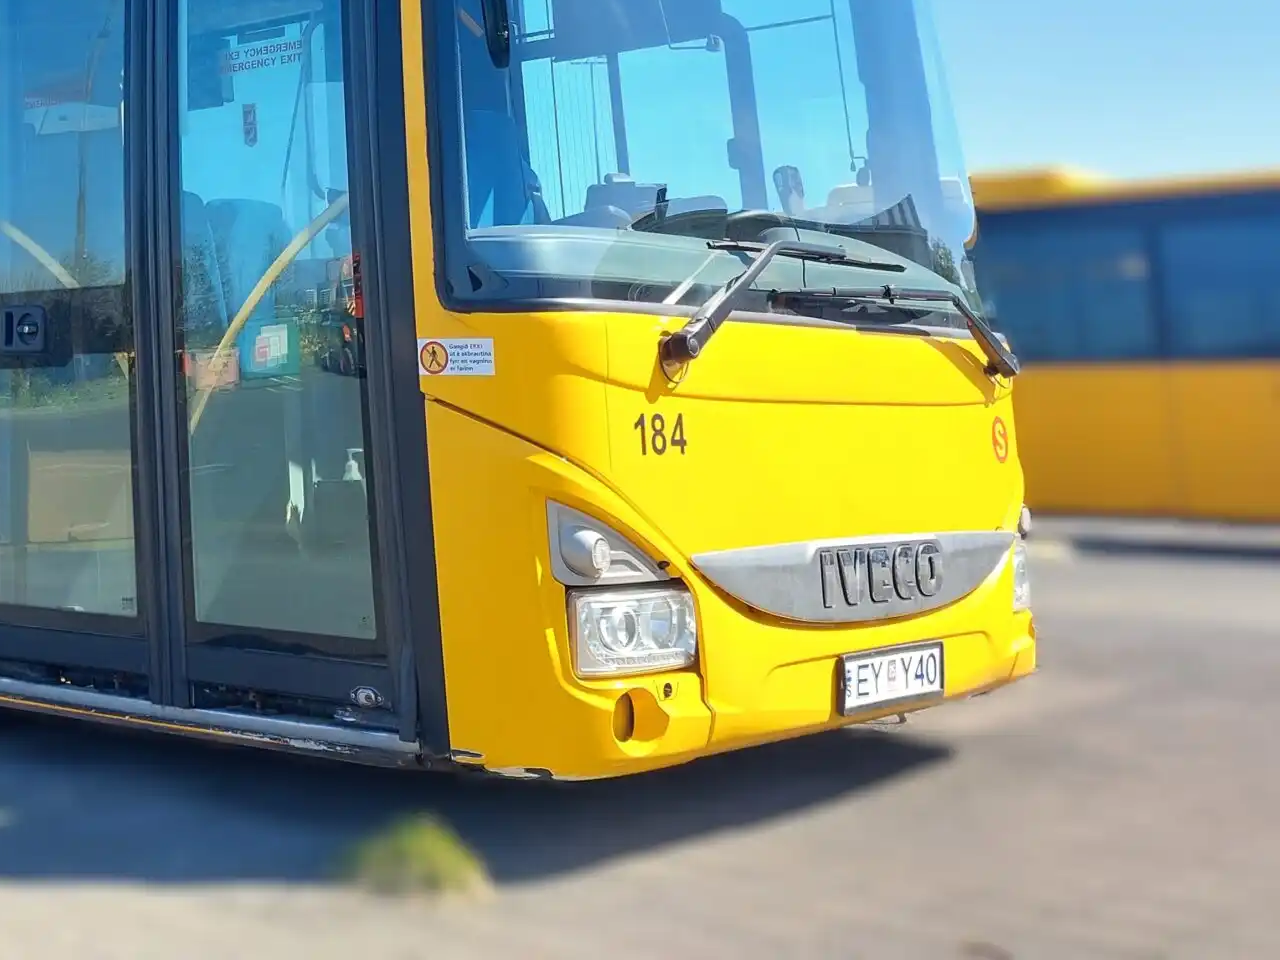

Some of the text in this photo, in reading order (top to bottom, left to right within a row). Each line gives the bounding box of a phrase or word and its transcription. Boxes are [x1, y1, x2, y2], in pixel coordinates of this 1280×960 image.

[223, 52, 303, 74] MERGENCY EXIT
[634, 412, 687, 456] 184
[819, 542, 943, 608] IVECO
[857, 661, 883, 696] EY
[900, 652, 937, 689] Y40
